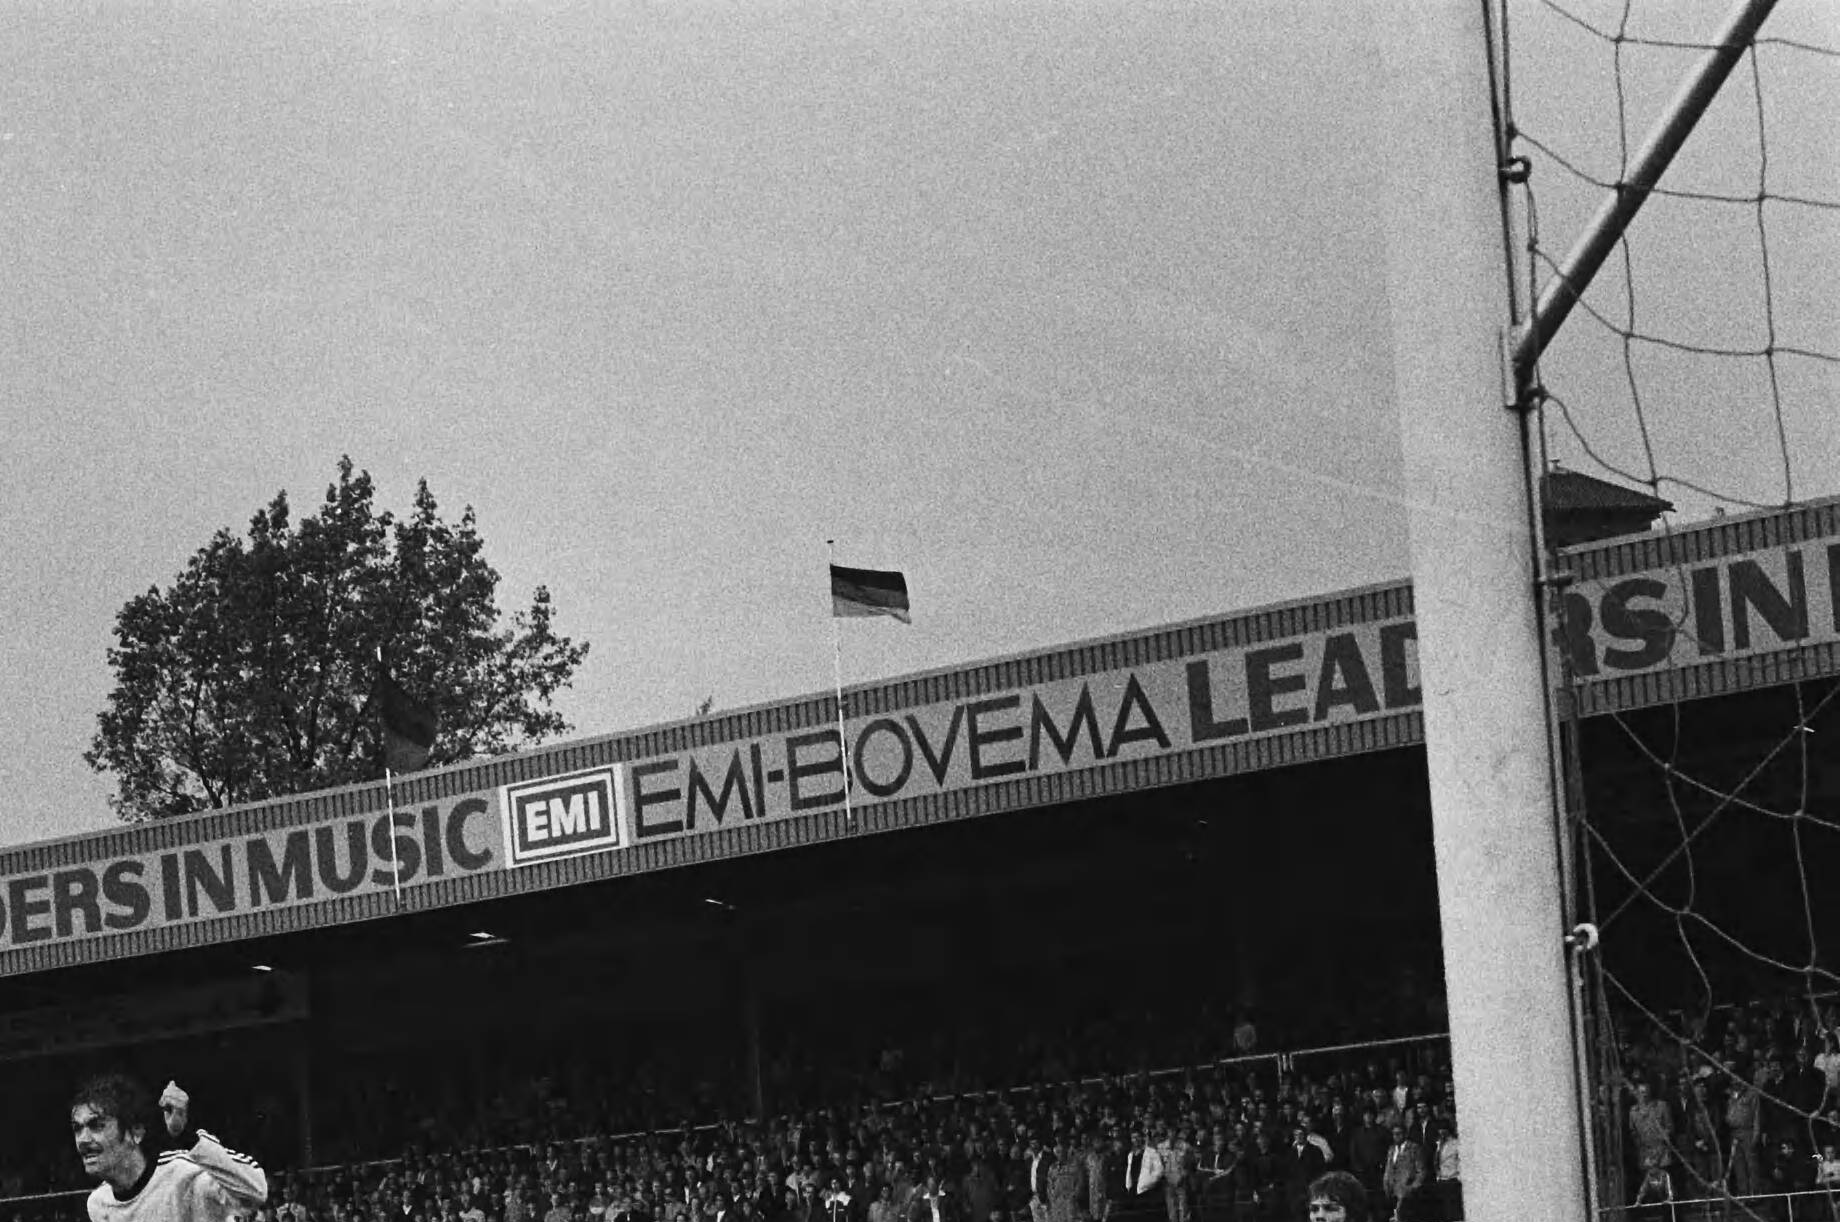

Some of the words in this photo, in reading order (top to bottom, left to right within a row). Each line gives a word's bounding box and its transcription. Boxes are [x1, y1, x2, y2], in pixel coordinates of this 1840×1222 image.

[632, 672, 1170, 838] EMI-BOVEMA
[1691, 549, 1810, 656] IN
[161, 843, 237, 921] IN
[246, 798, 493, 909] MUSIC
[526, 790, 601, 842] EMI
